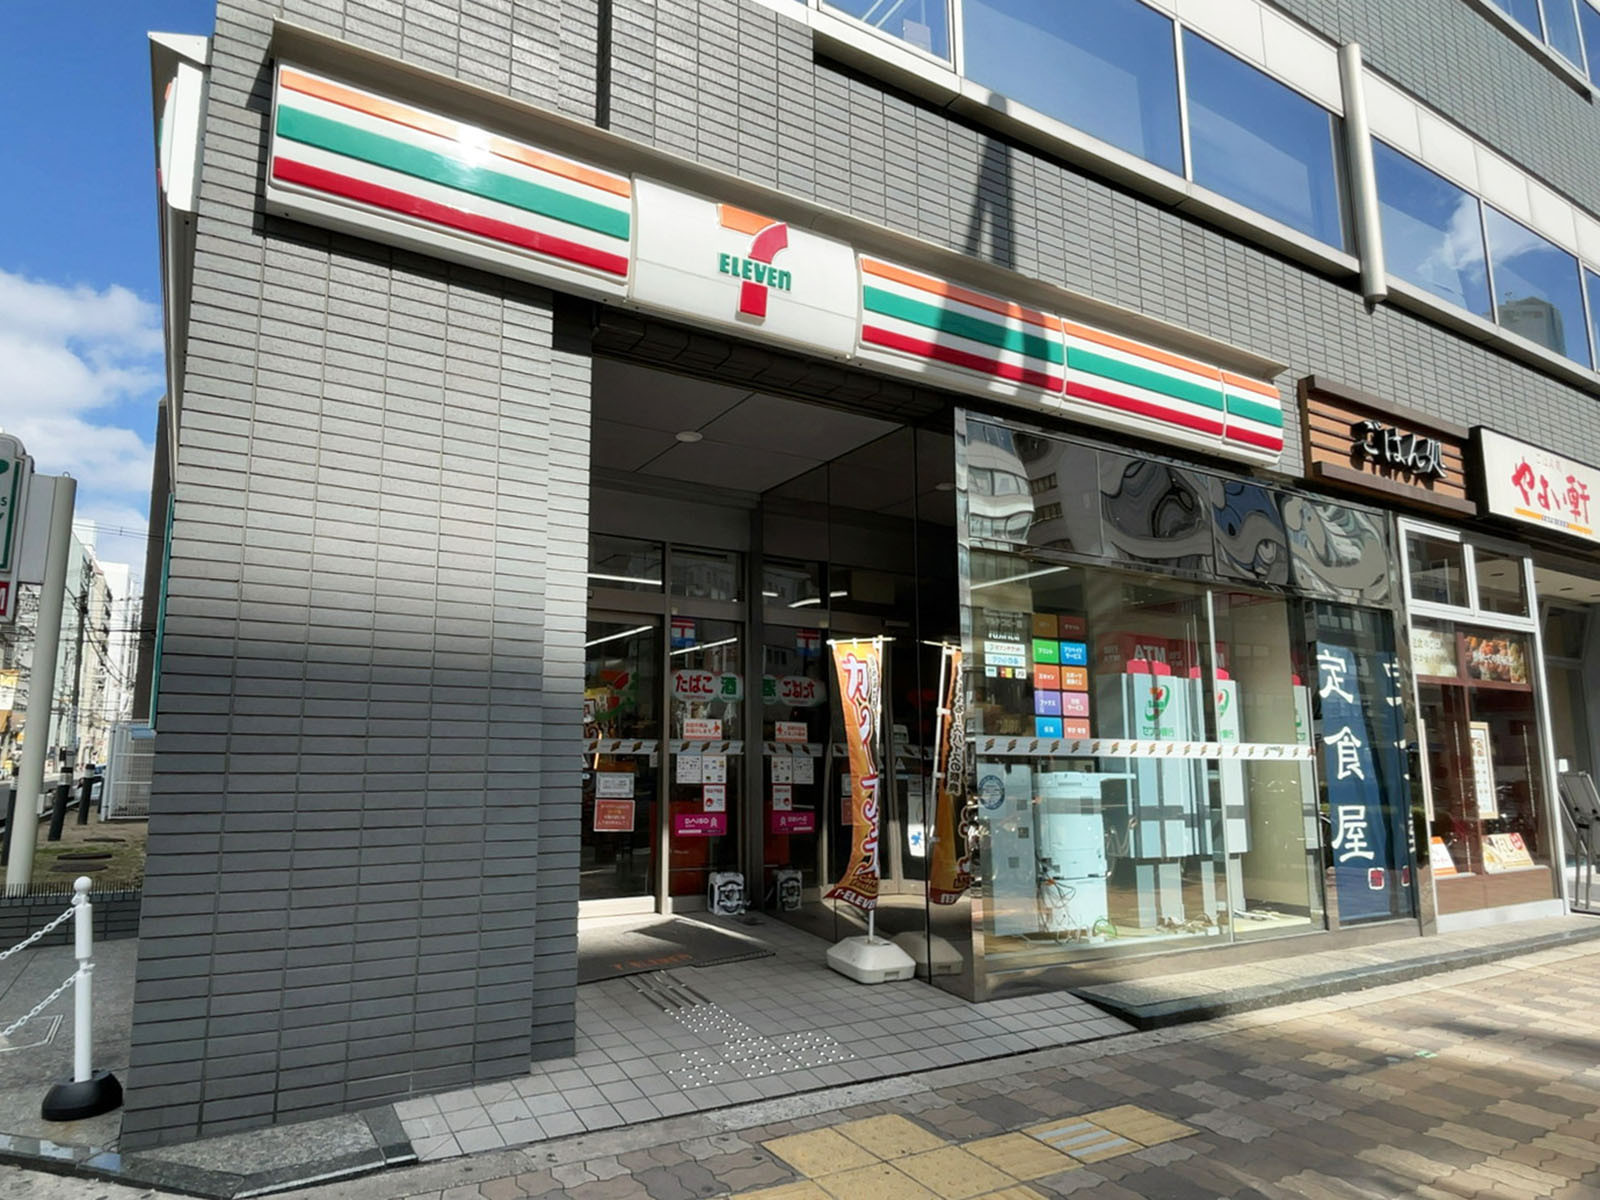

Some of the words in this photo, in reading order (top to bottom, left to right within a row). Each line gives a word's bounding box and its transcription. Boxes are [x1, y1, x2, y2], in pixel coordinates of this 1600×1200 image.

[719, 252, 793, 292] ELEVEn
[1362, 420, 1448, 479] ごはん処
[1511, 456, 1591, 525] やよい軒
[1133, 644, 1167, 663] ATM
[675, 673, 714, 694] たばこ
[720, 676, 737, 695] 酒
[1315, 649, 1376, 863] 定食屋
